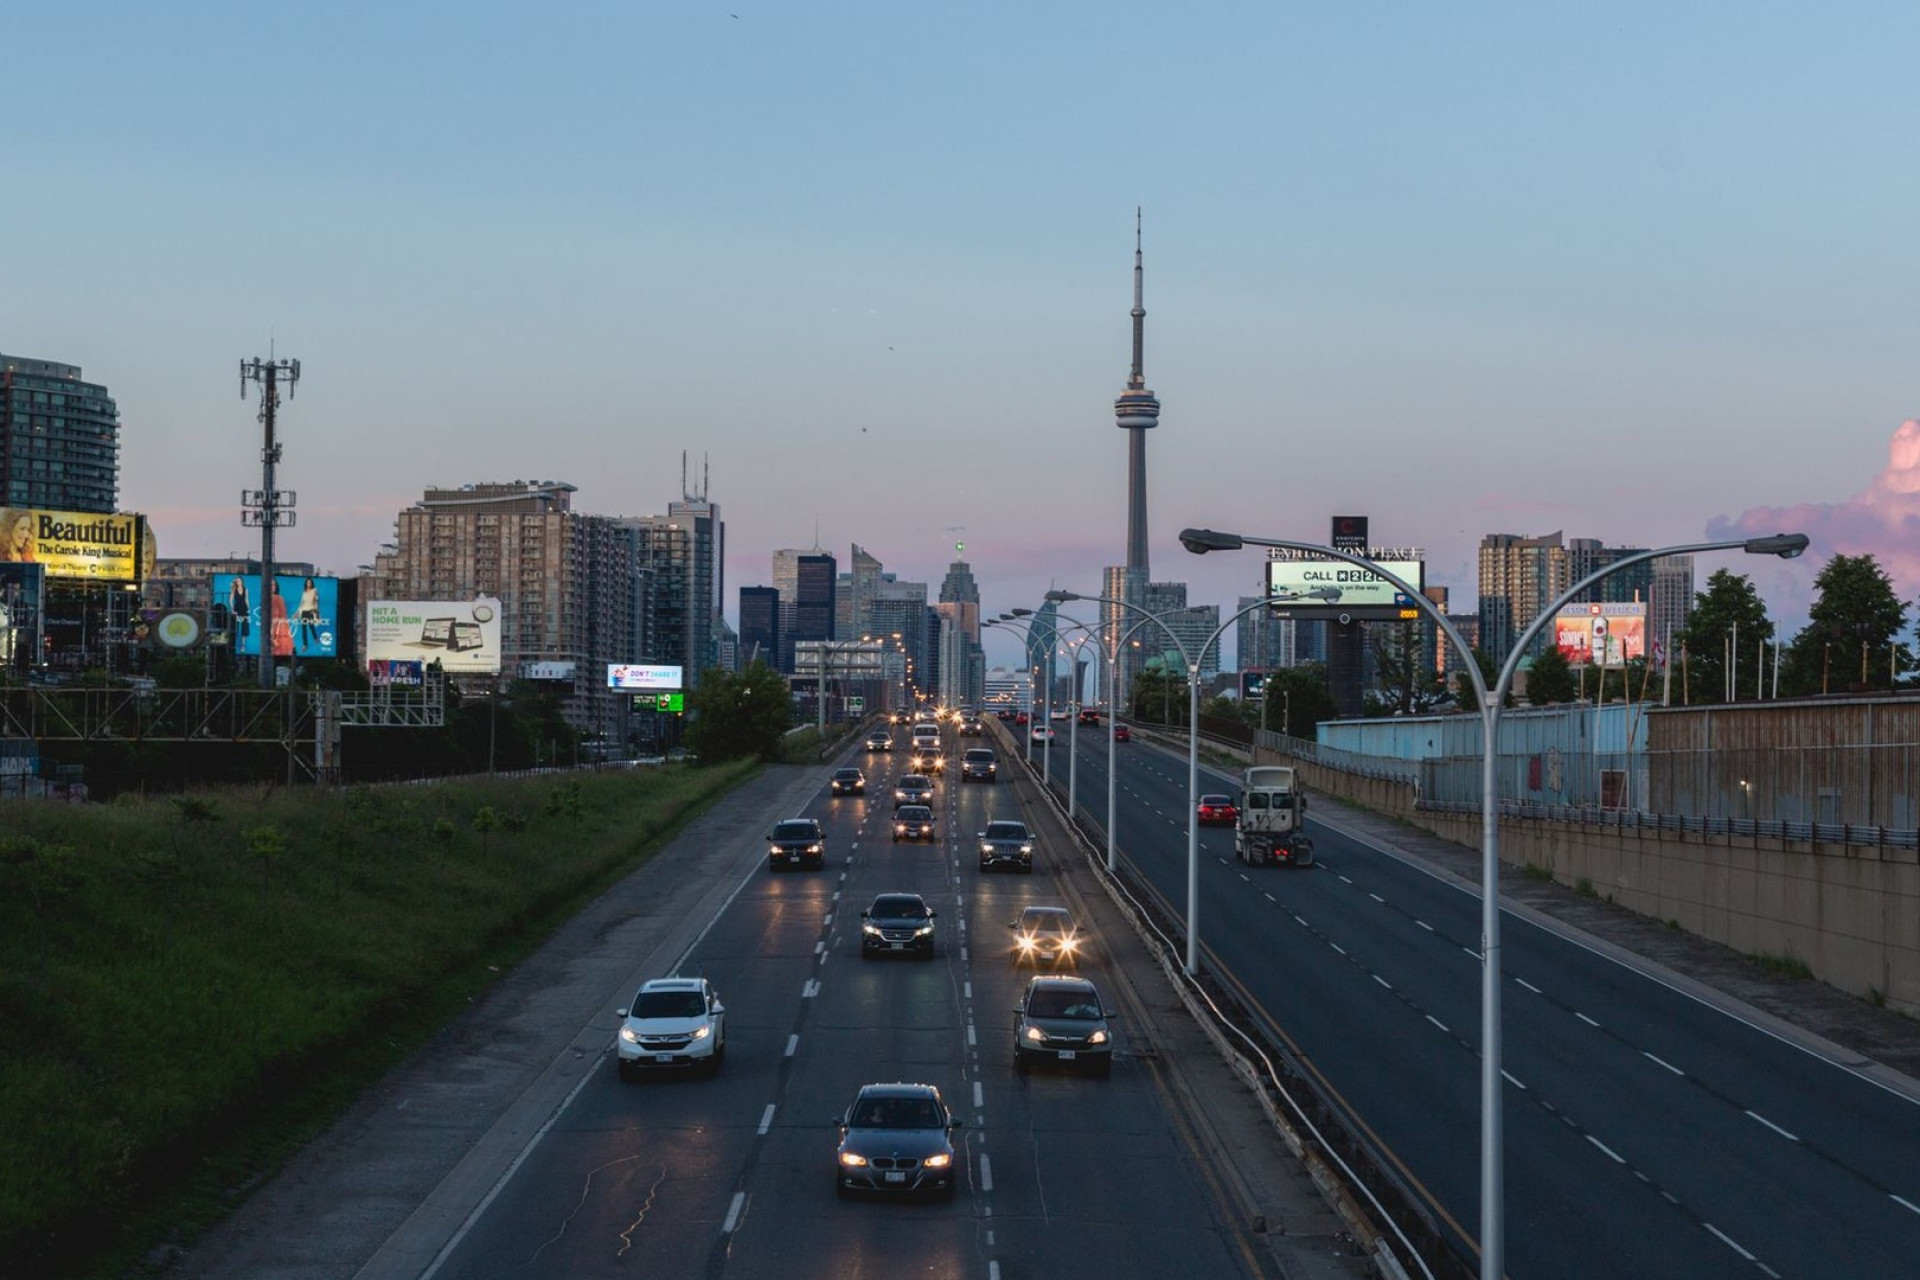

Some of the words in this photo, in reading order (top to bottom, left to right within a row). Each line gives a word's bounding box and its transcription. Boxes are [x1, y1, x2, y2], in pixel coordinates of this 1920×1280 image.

[38, 514, 131, 545] Beautiful
[38, 543, 54, 553] The
[55, 544, 81, 556] Carole
[82, 545, 101, 559] King
[102, 547, 131, 559] Musical
[1303, 571, 1333, 581] CALL
[372, 607, 388, 616] HIT
[390, 608, 398, 616] A
[372, 616, 400, 625] HOME
[402, 616, 421, 625] RUN
